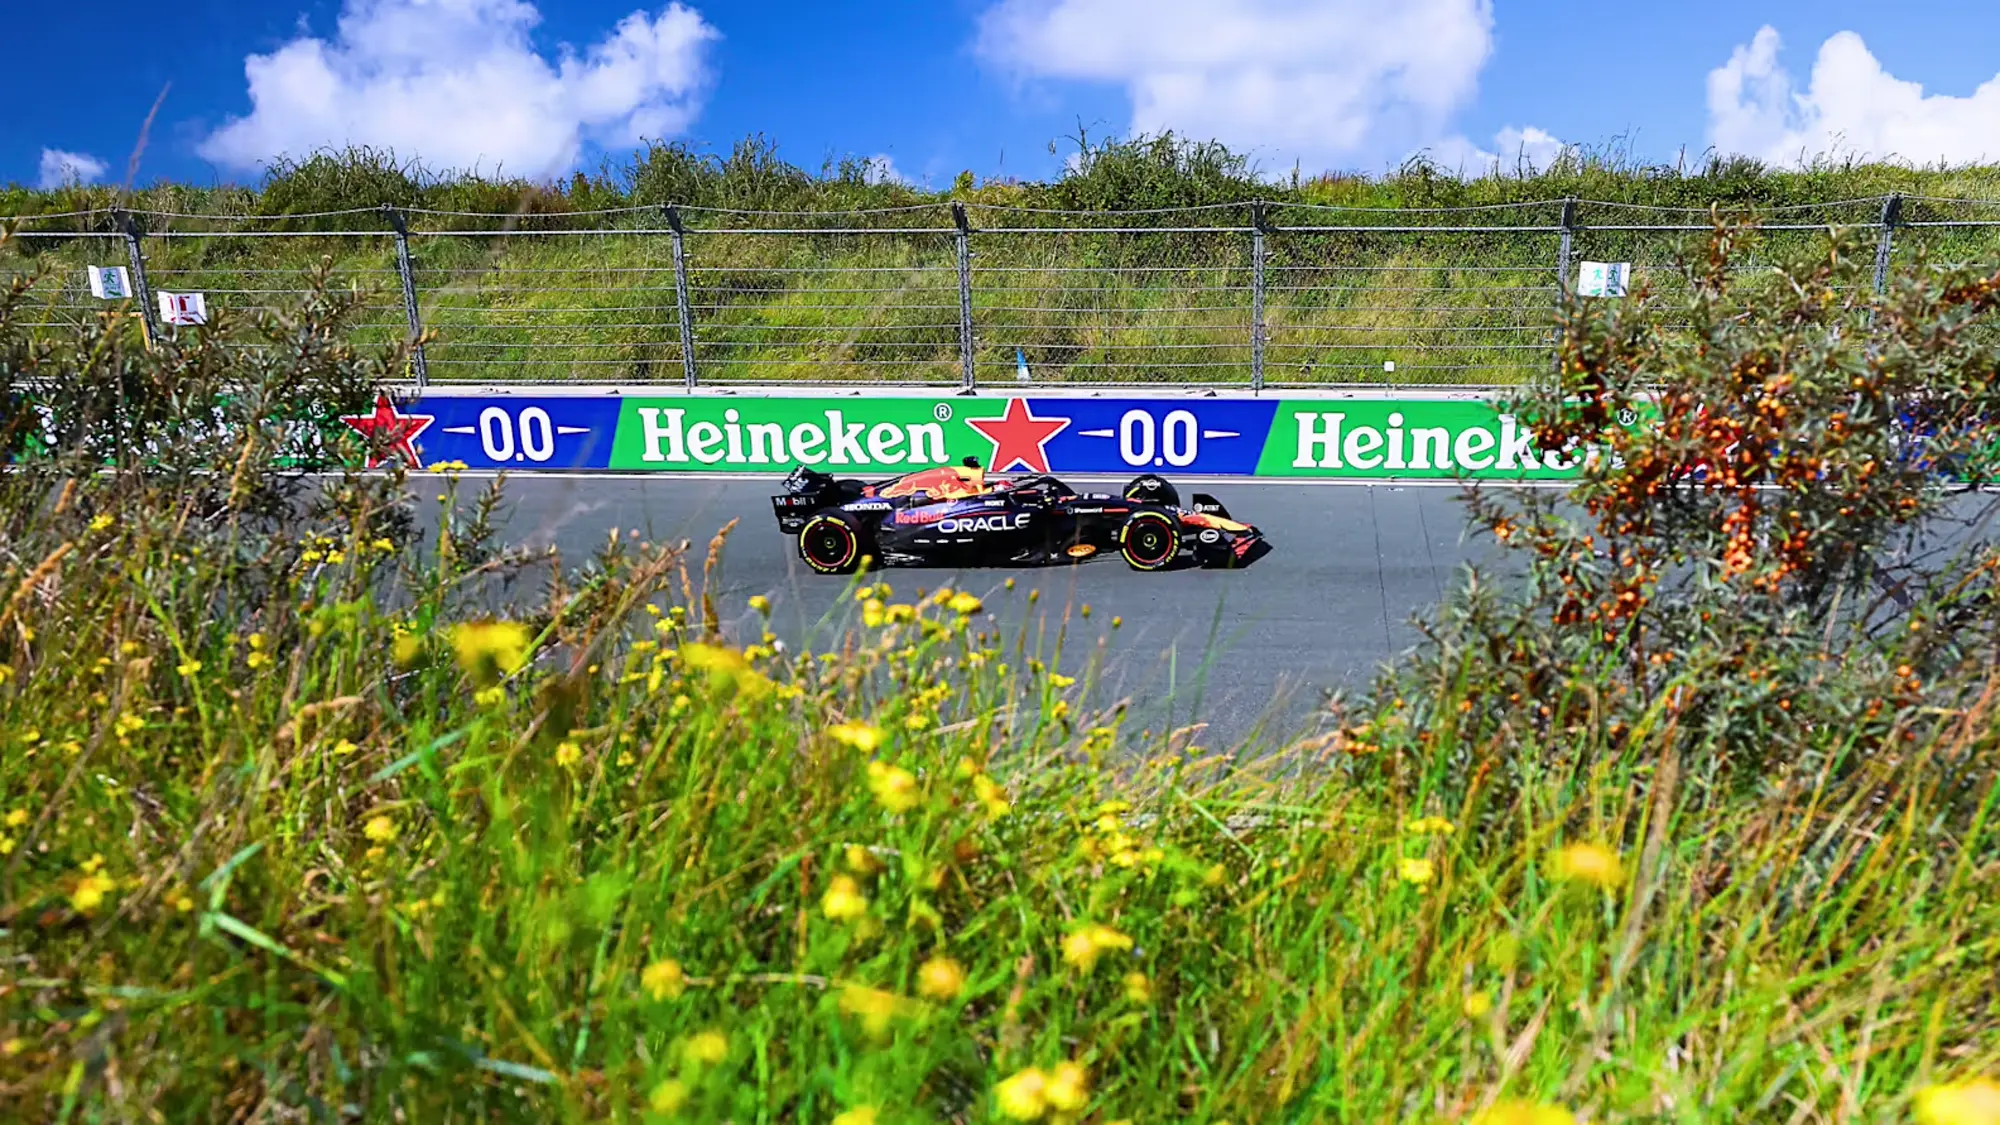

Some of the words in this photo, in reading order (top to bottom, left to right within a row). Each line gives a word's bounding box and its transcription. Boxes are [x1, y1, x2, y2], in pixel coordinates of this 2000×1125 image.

[637, 407, 950, 465] Heineken
[1292, 411, 1626, 471] Heinek
[842, 502, 893, 512] HONDA
[896, 509, 920, 524] Red
[920, 511, 946, 523] Bull
[937, 512, 1031, 533] ORACLE
